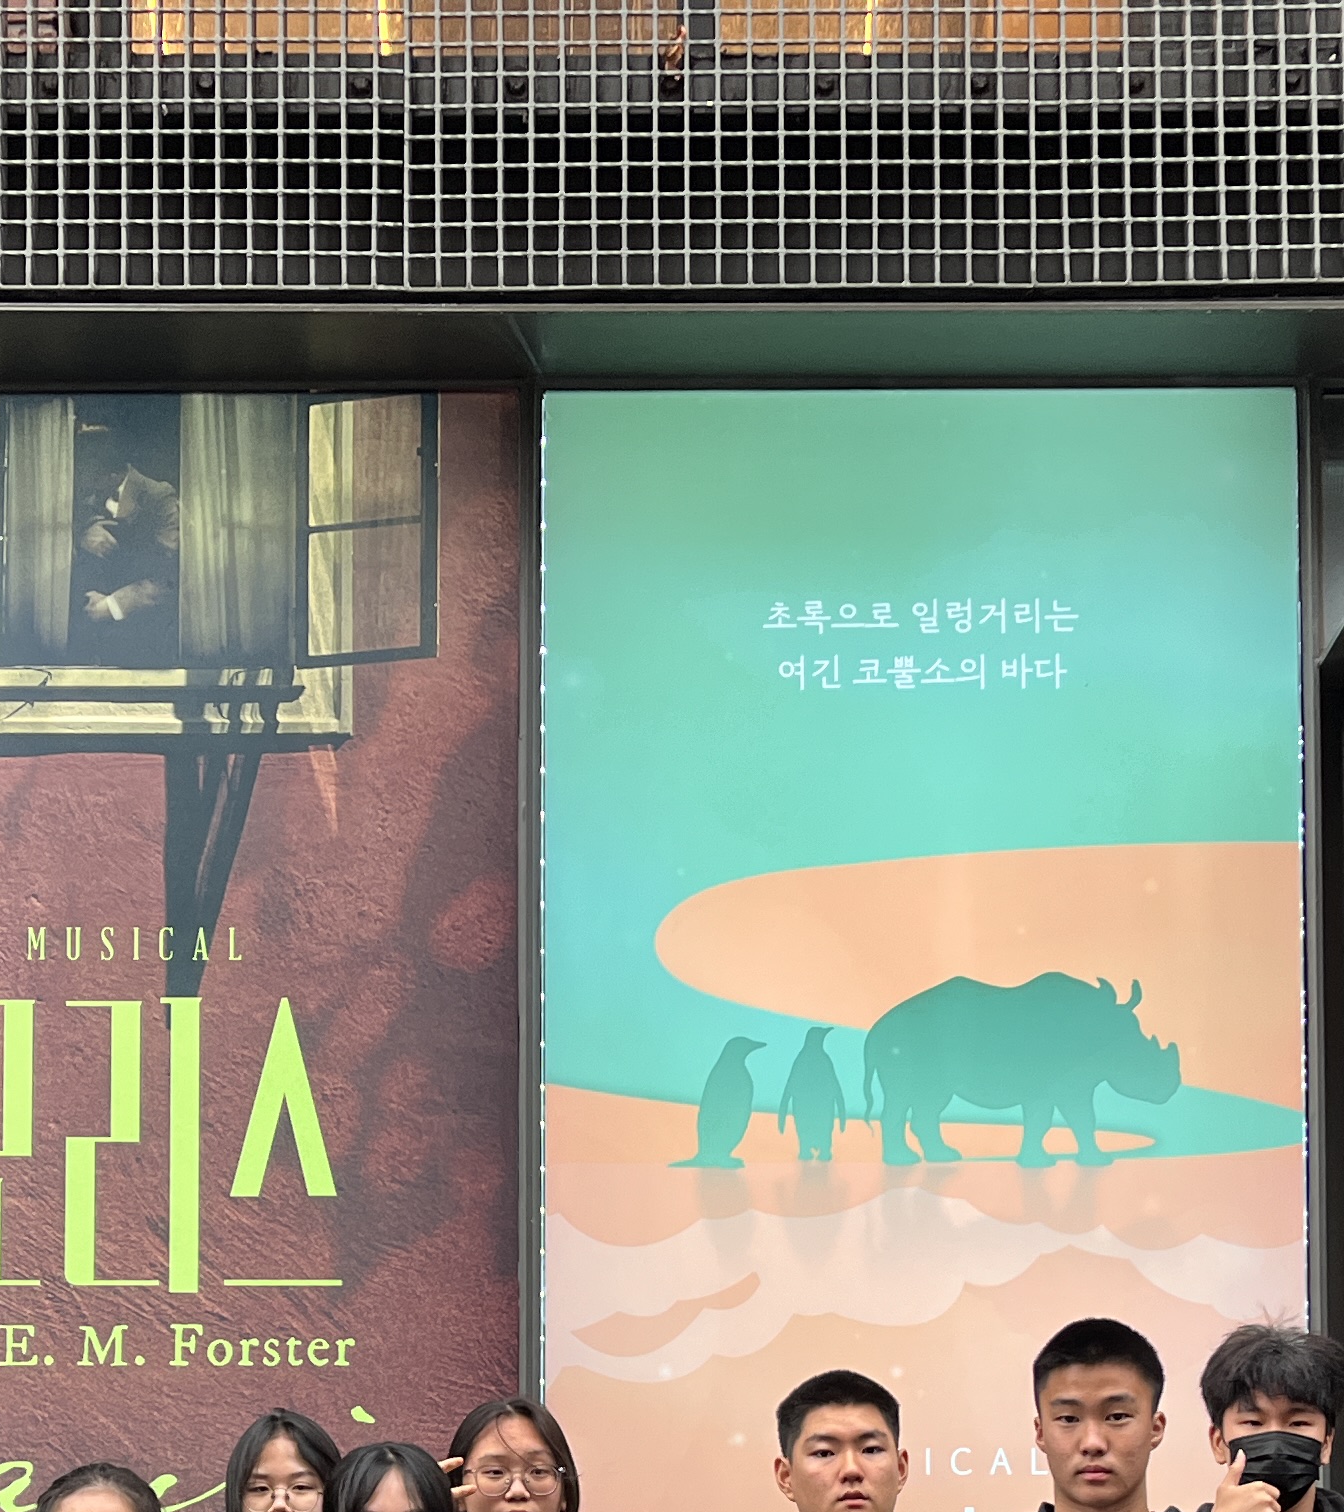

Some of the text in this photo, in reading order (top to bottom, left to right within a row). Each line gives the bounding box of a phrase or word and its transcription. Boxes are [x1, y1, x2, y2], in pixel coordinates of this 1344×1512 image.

[762, 597, 1080, 634] 초록으로 일렁거리는
[778, 653, 1068, 691] 여긴 코뿔소의 바다
[27, 926, 242, 961] MUSICAL
[0, 1324, 55, 1367] E.
[77, 1325, 146, 1367] M.
[168, 1323, 356, 1368] Forster
